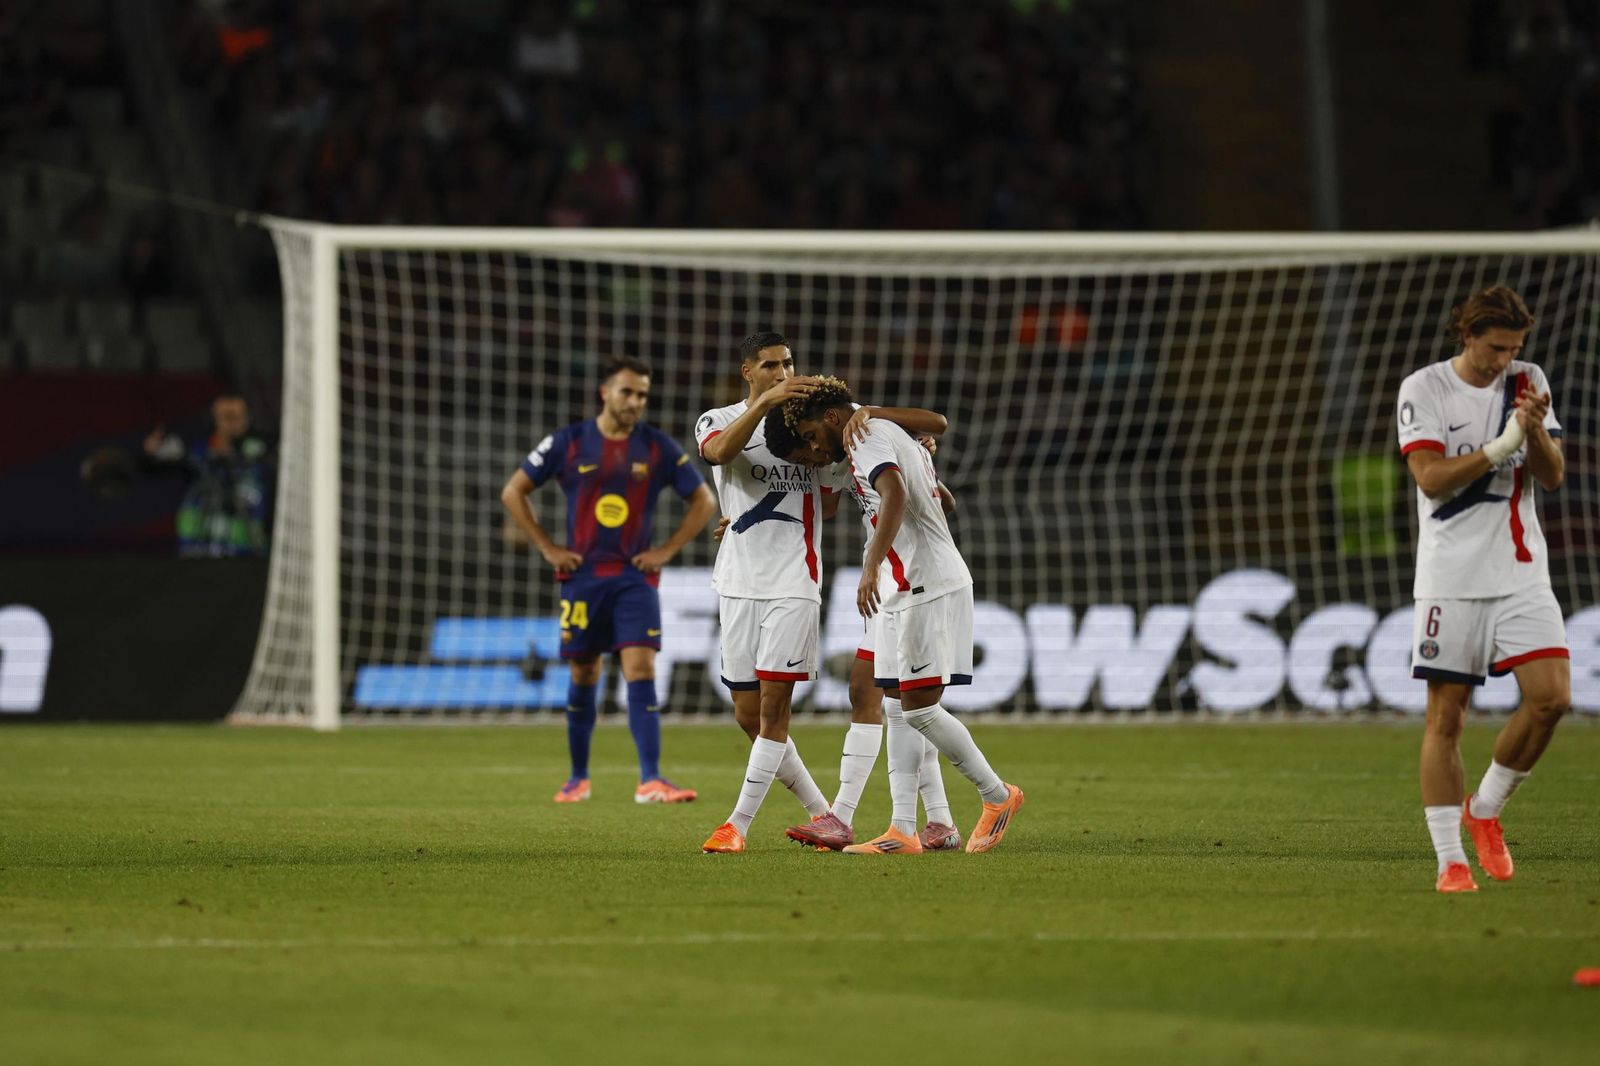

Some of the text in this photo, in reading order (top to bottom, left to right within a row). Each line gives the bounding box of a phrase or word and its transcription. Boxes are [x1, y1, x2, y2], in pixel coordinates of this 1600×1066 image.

[751, 464, 812, 483] QATAR
[768, 481, 813, 492] AIRWAYS
[560, 599, 588, 630] 24
[1426, 606, 1442, 637] 6
